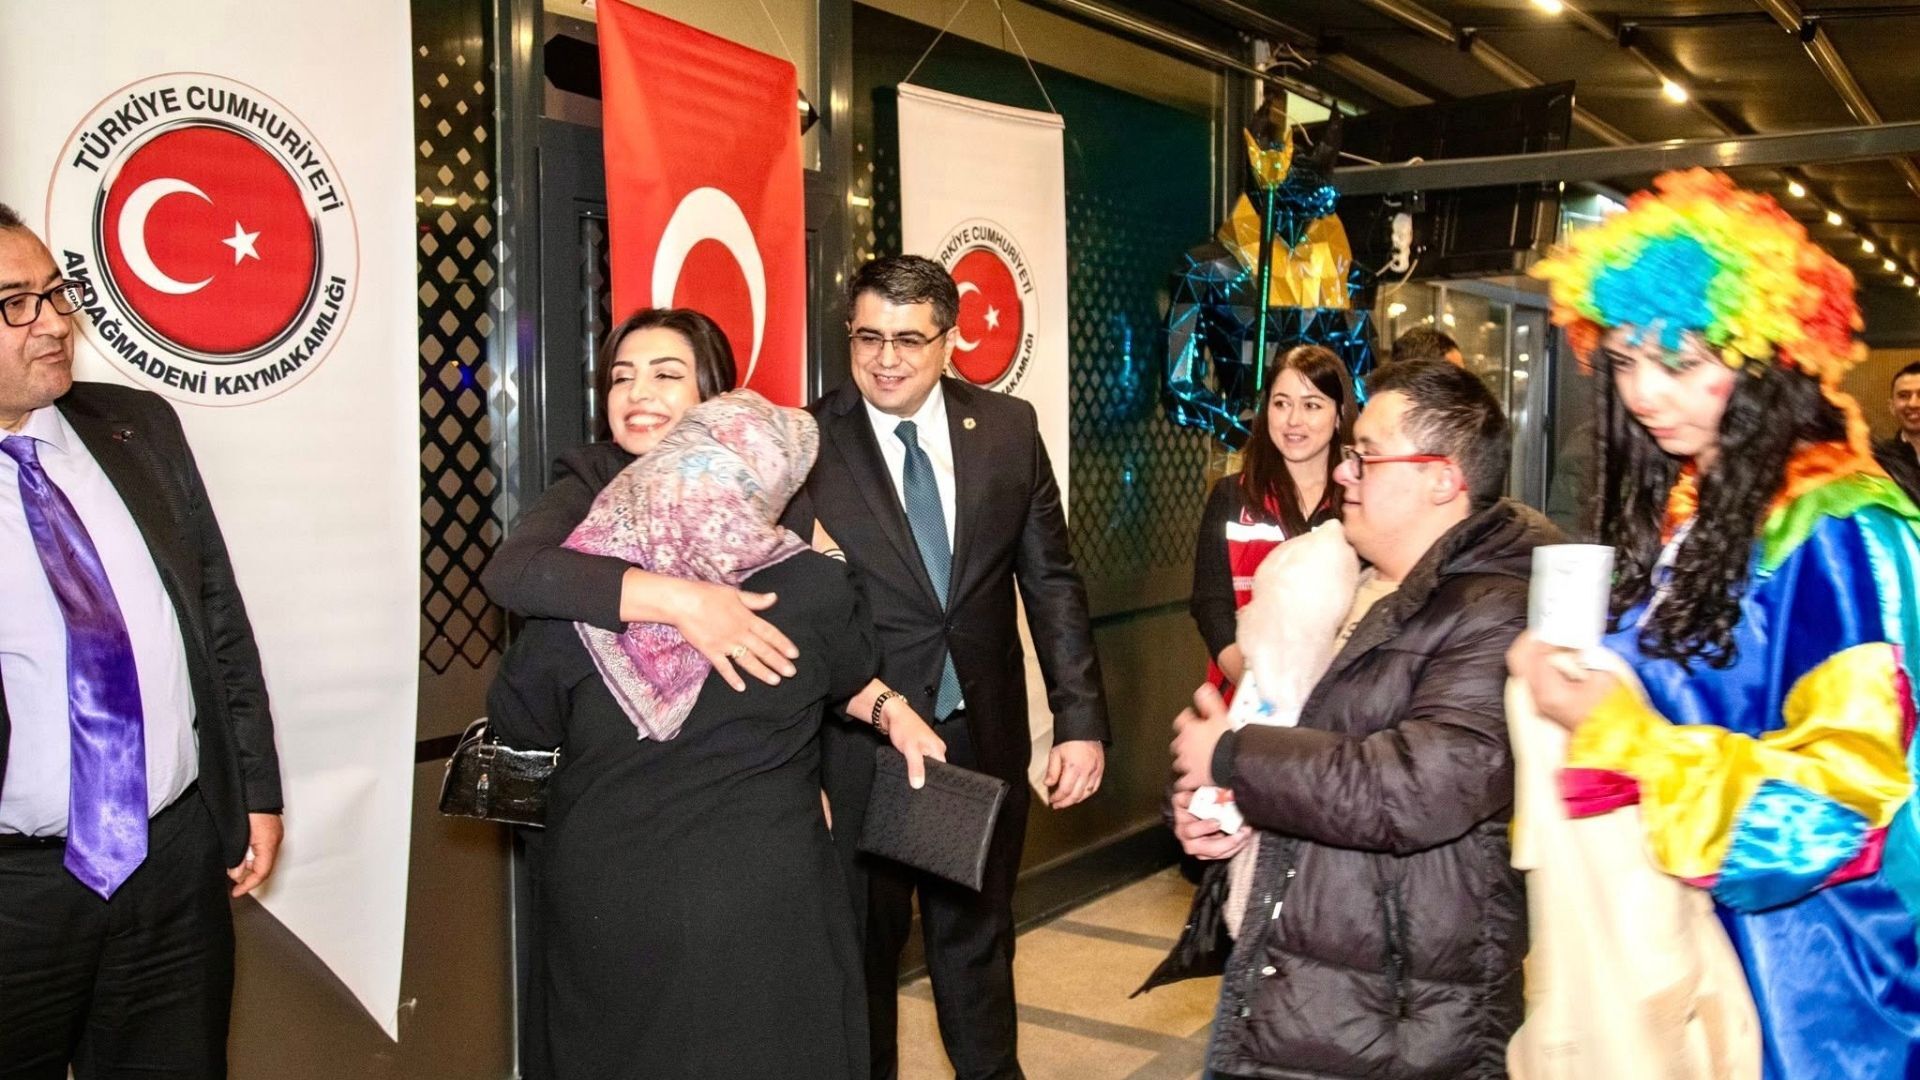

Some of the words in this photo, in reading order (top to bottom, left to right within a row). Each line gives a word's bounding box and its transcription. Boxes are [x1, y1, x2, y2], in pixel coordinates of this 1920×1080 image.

[73, 87, 182, 175] TÜRKİYE
[186, 86, 344, 213] CUMHURİYETİ
[63, 249, 207, 395] AKDAĞMADENİ
[215, 275, 347, 395] KAYMAKAMLIĞI
[940, 229, 970, 265] RKİYE
[972, 226, 1033, 294] CUMHURİYETİ
